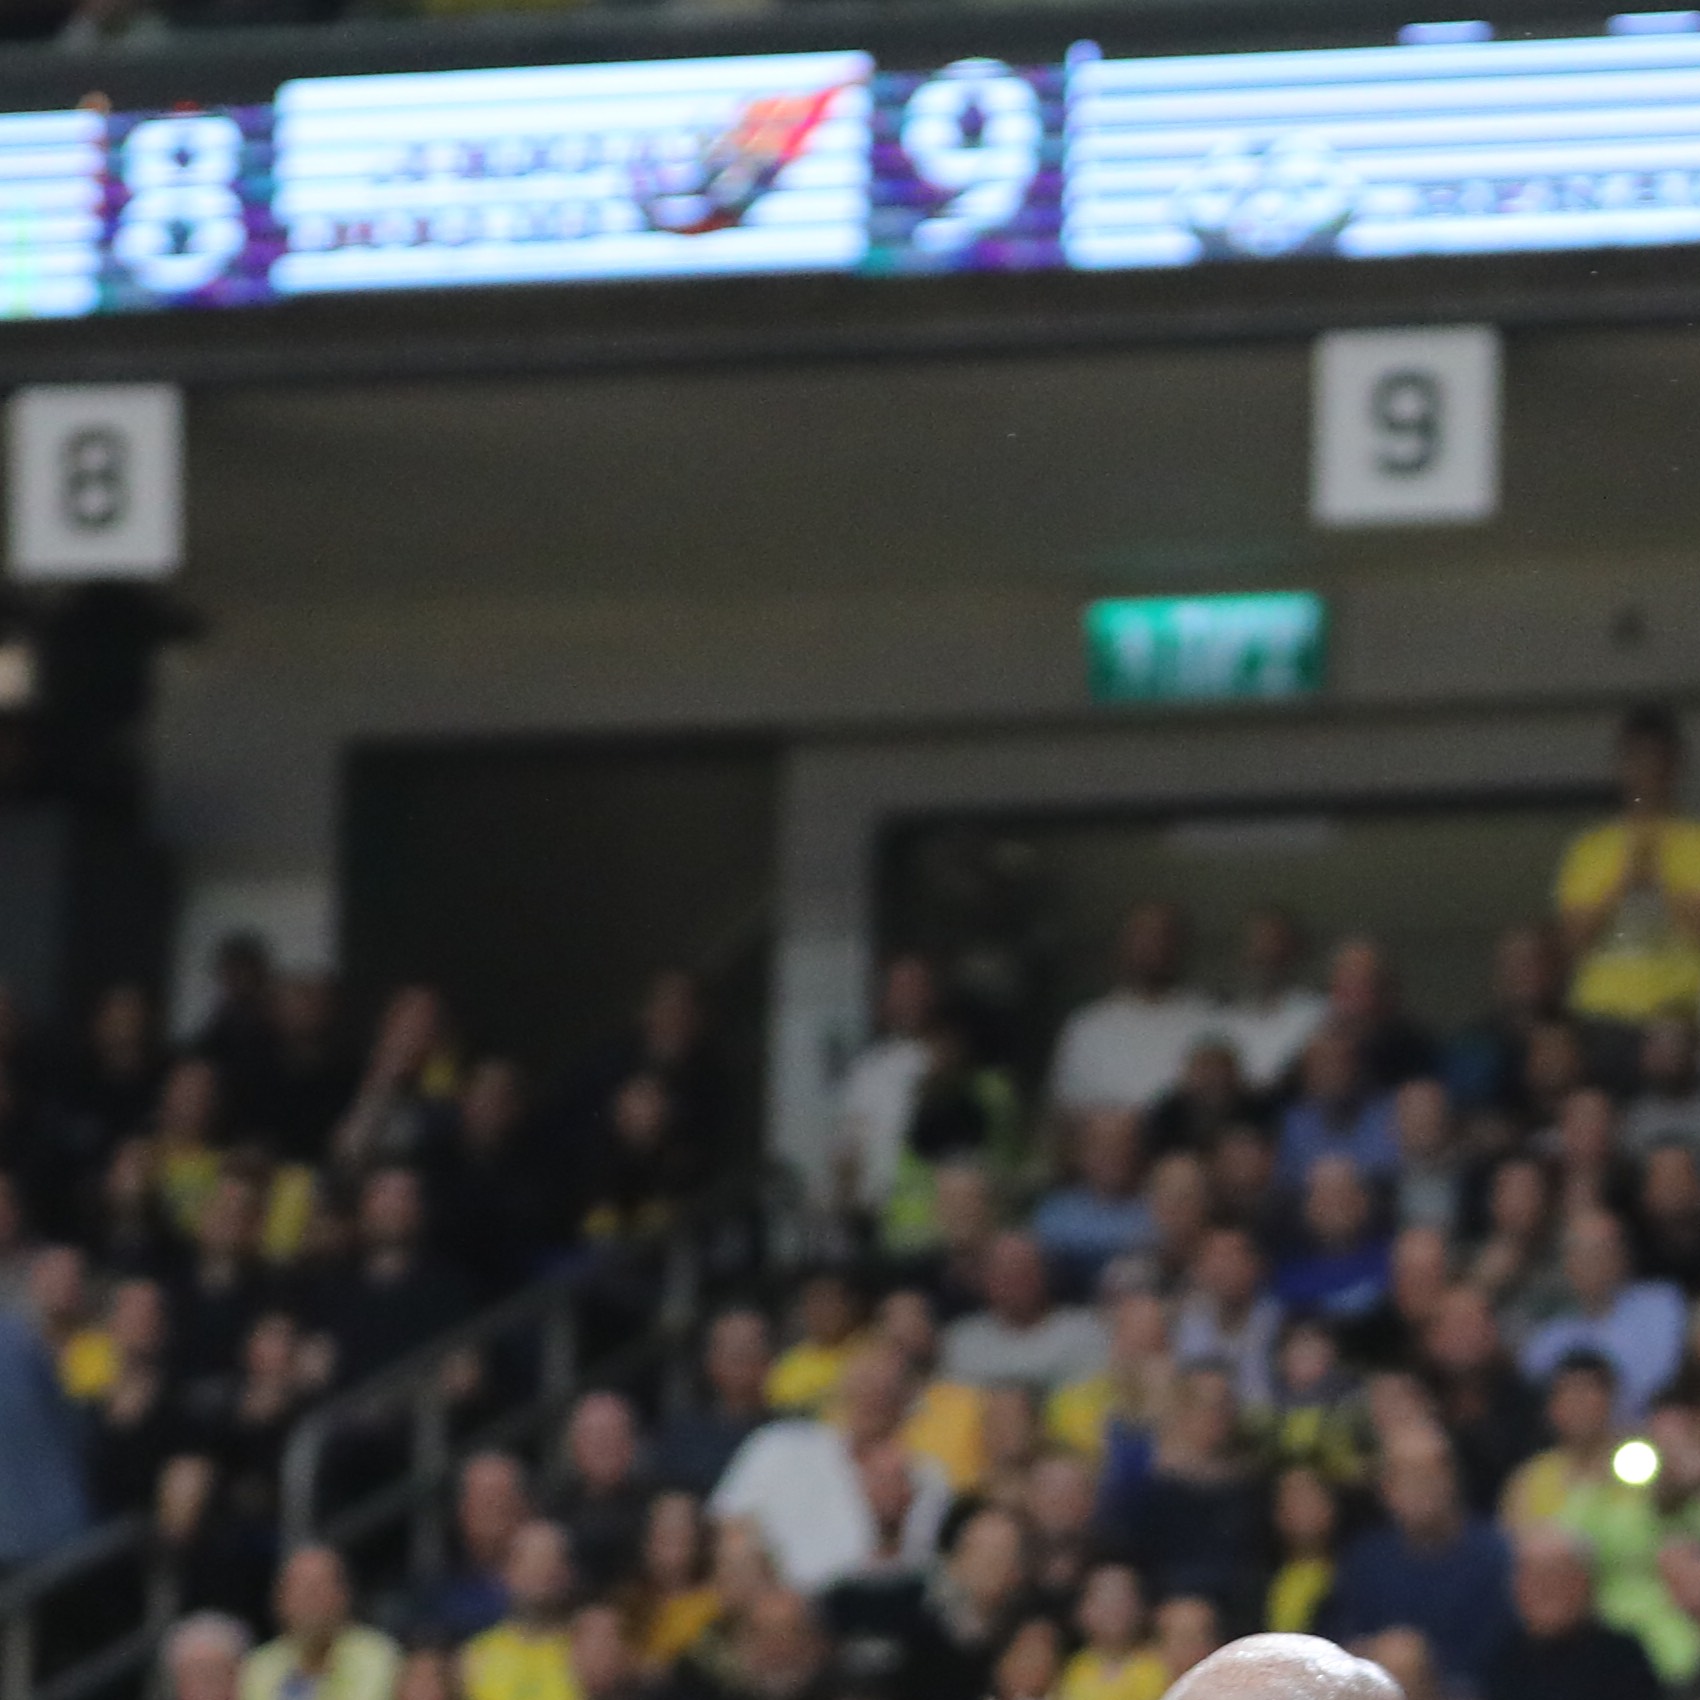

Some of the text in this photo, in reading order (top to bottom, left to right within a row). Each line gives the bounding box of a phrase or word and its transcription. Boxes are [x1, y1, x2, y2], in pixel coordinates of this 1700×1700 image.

[114, 115, 247, 294] 8
[900, 57, 1042, 254] 9
[60, 425, 130, 531] 8
[1369, 369, 1446, 475] 9
